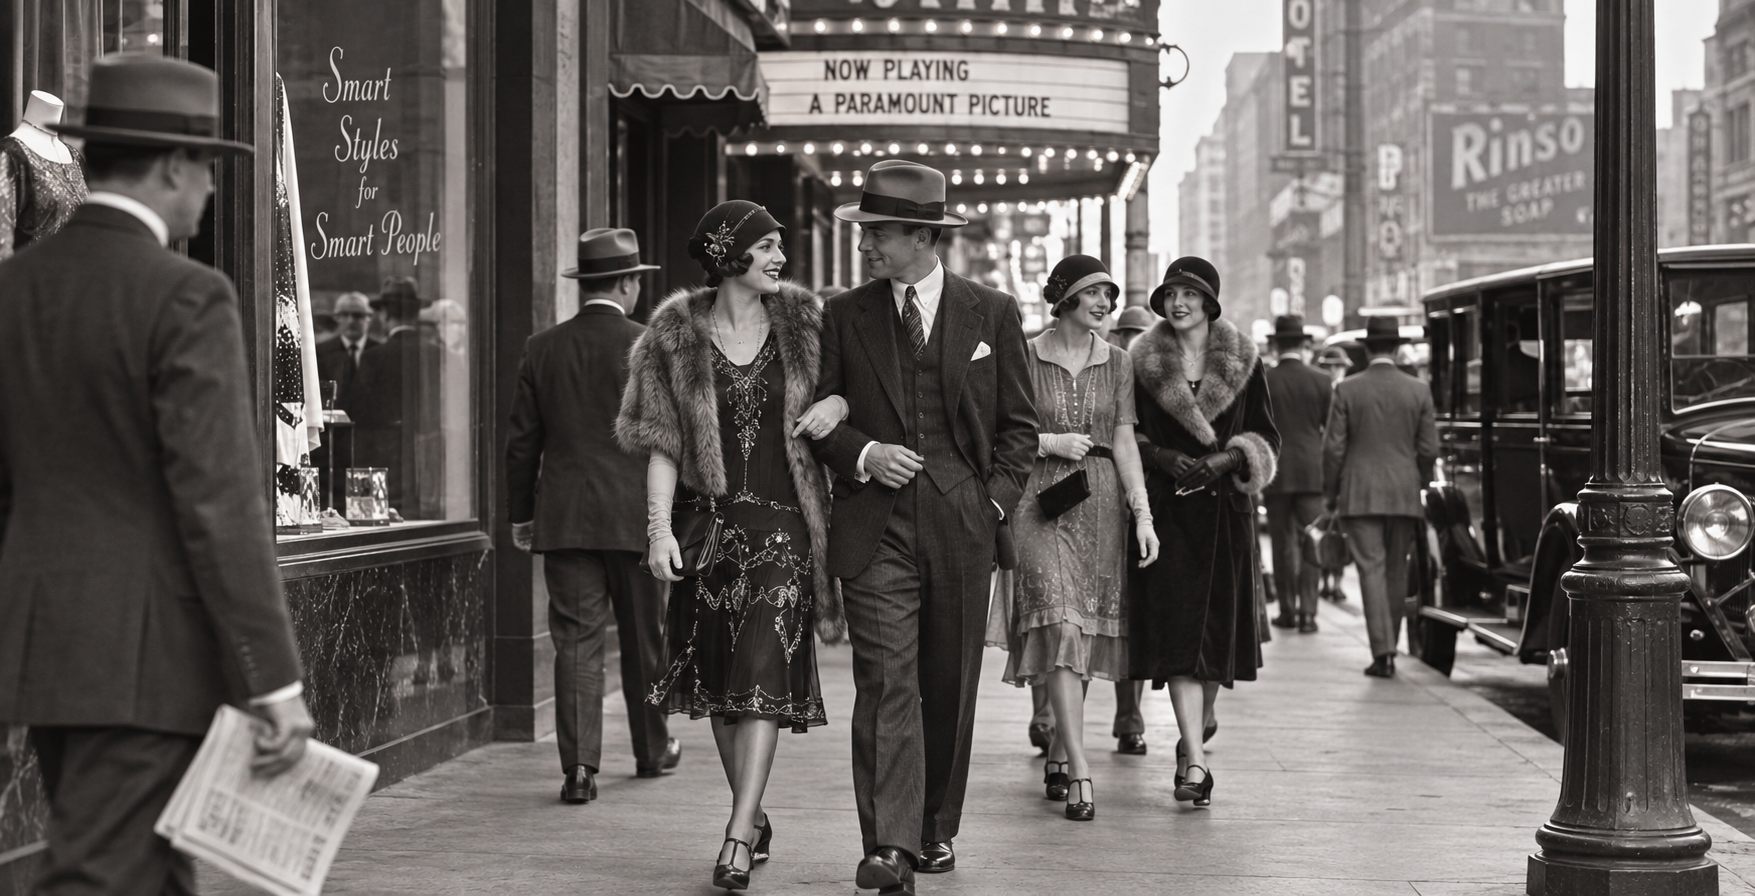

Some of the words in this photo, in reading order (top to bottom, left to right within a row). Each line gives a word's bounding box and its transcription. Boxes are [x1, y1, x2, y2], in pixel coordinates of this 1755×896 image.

[323, 46, 392, 103] Smart
[823, 59, 871, 81] NOW
[884, 59, 969, 81] PLAYING
[809, 93, 823, 115] A
[835, 93, 958, 116] PARAMOUNT
[968, 94, 1051, 118] PICTURE
[334, 114, 399, 174] Styles
[1452, 116, 1585, 190] Rinso
[355, 176, 379, 208] for
[1465, 188, 1500, 213] THE
[1506, 170, 1586, 204] GREATER
[1500, 197, 1554, 227] SOAP
[310, 211, 375, 260] Smart
[380, 209, 441, 266] People
